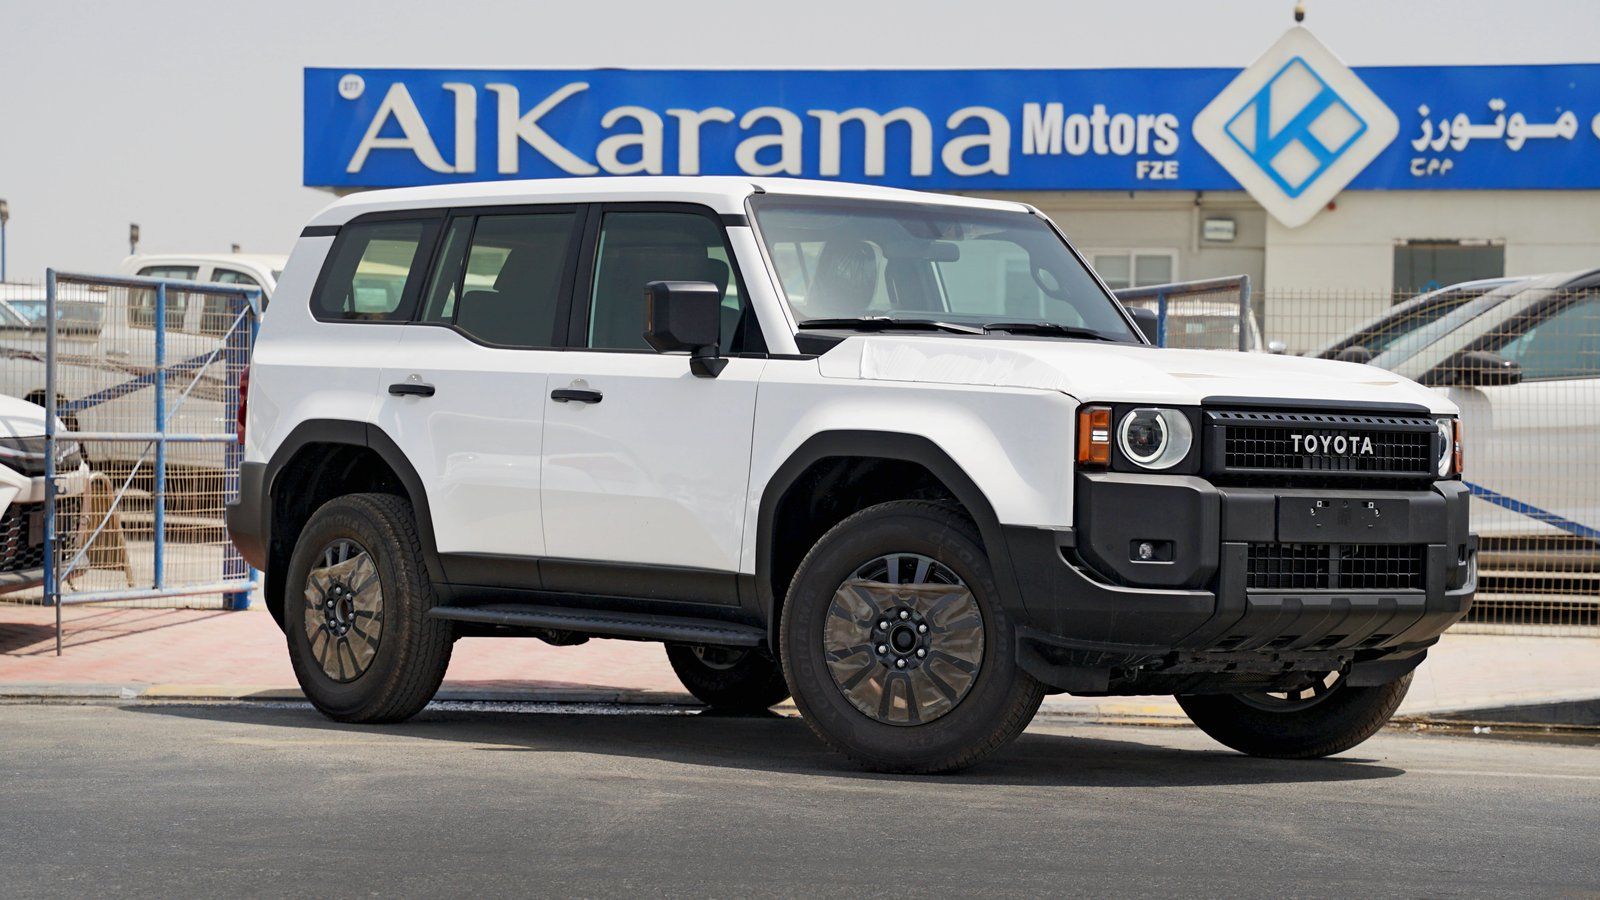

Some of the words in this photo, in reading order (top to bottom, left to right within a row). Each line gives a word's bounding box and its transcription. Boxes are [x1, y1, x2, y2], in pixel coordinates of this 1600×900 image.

[1022, 102, 1179, 156] Motors
[1411, 98, 1578, 151] موتورز
[1136, 160, 1179, 180] FZE
[1291, 434, 1373, 455] TOYOTA
